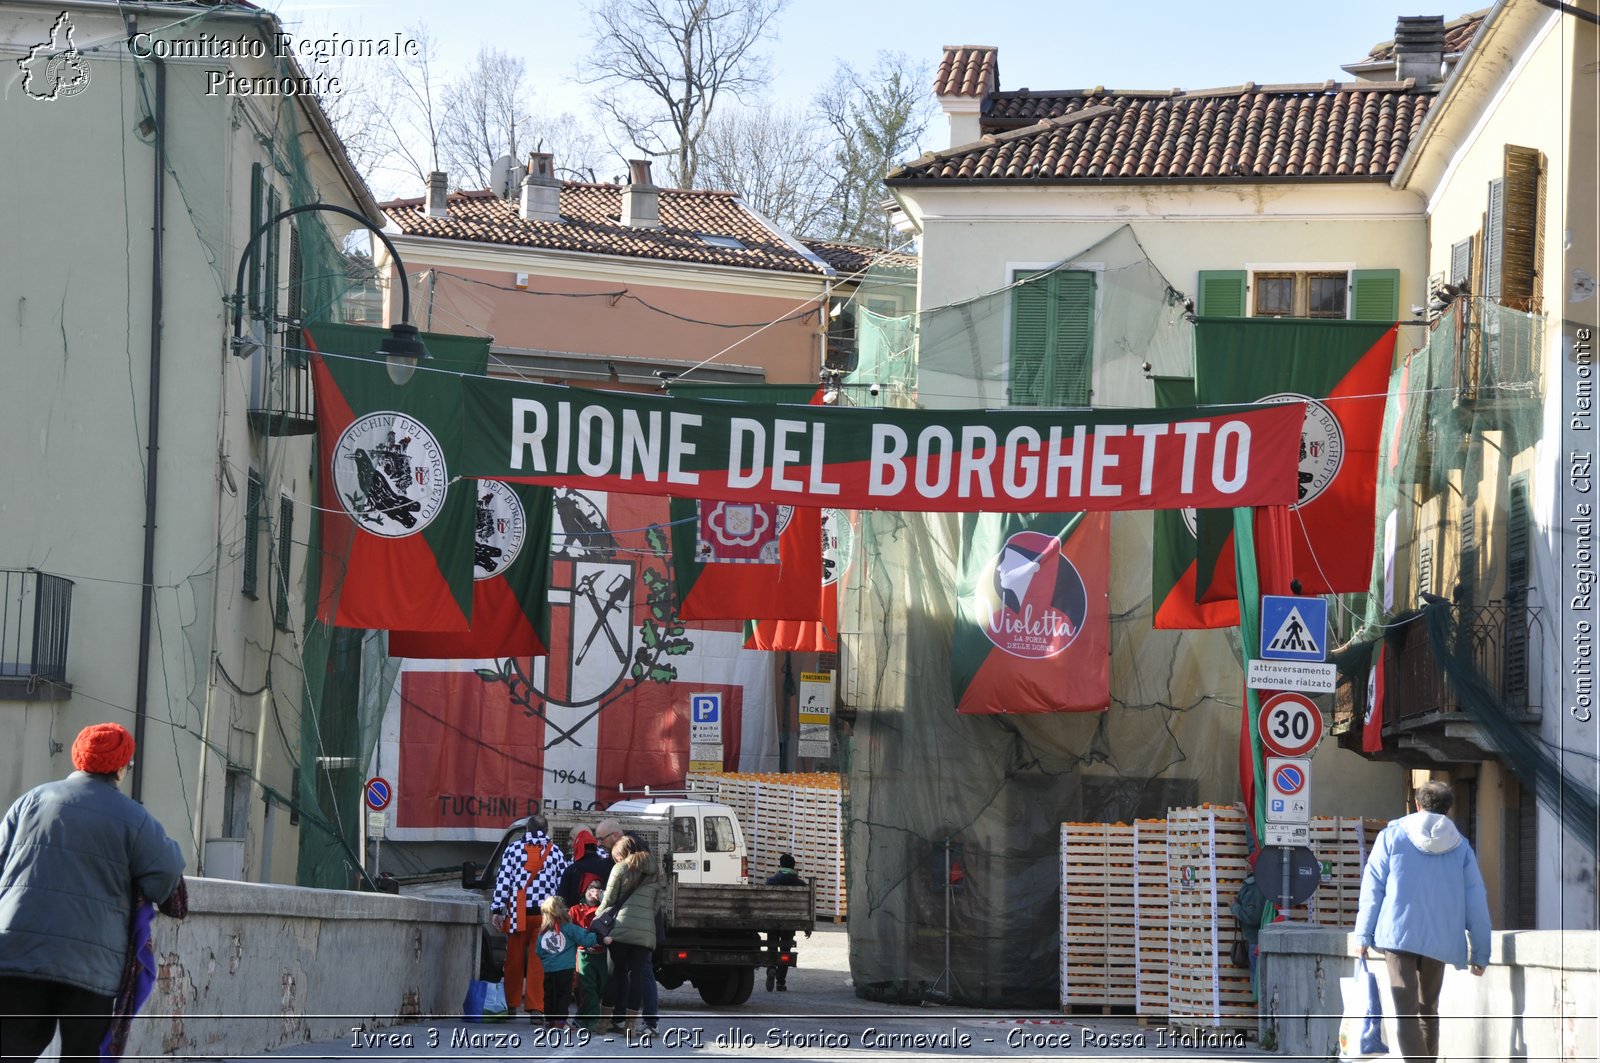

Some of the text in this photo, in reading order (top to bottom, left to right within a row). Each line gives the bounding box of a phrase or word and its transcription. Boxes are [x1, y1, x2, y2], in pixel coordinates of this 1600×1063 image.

[510, 397, 1252, 499] RIONE DEL BORGHETTO
[1306, 403, 1339, 489] EL BORGHETTO
[347, 416, 396, 443] TUCHINI
[400, 419, 421, 440] DEL
[421, 440, 443, 519] BORGHETTO
[482, 479, 522, 563] DEL BORGHETTO
[987, 591, 1077, 637] Violetta
[1014, 634, 1023, 642] LA
[1251, 676, 1332, 688] pedonale rialzato
[1253, 664, 1331, 676] attraversamento
[1273, 709, 1309, 740] 30
[552, 769, 587, 784] 1964
[439, 796, 517, 817] TUCHINI
